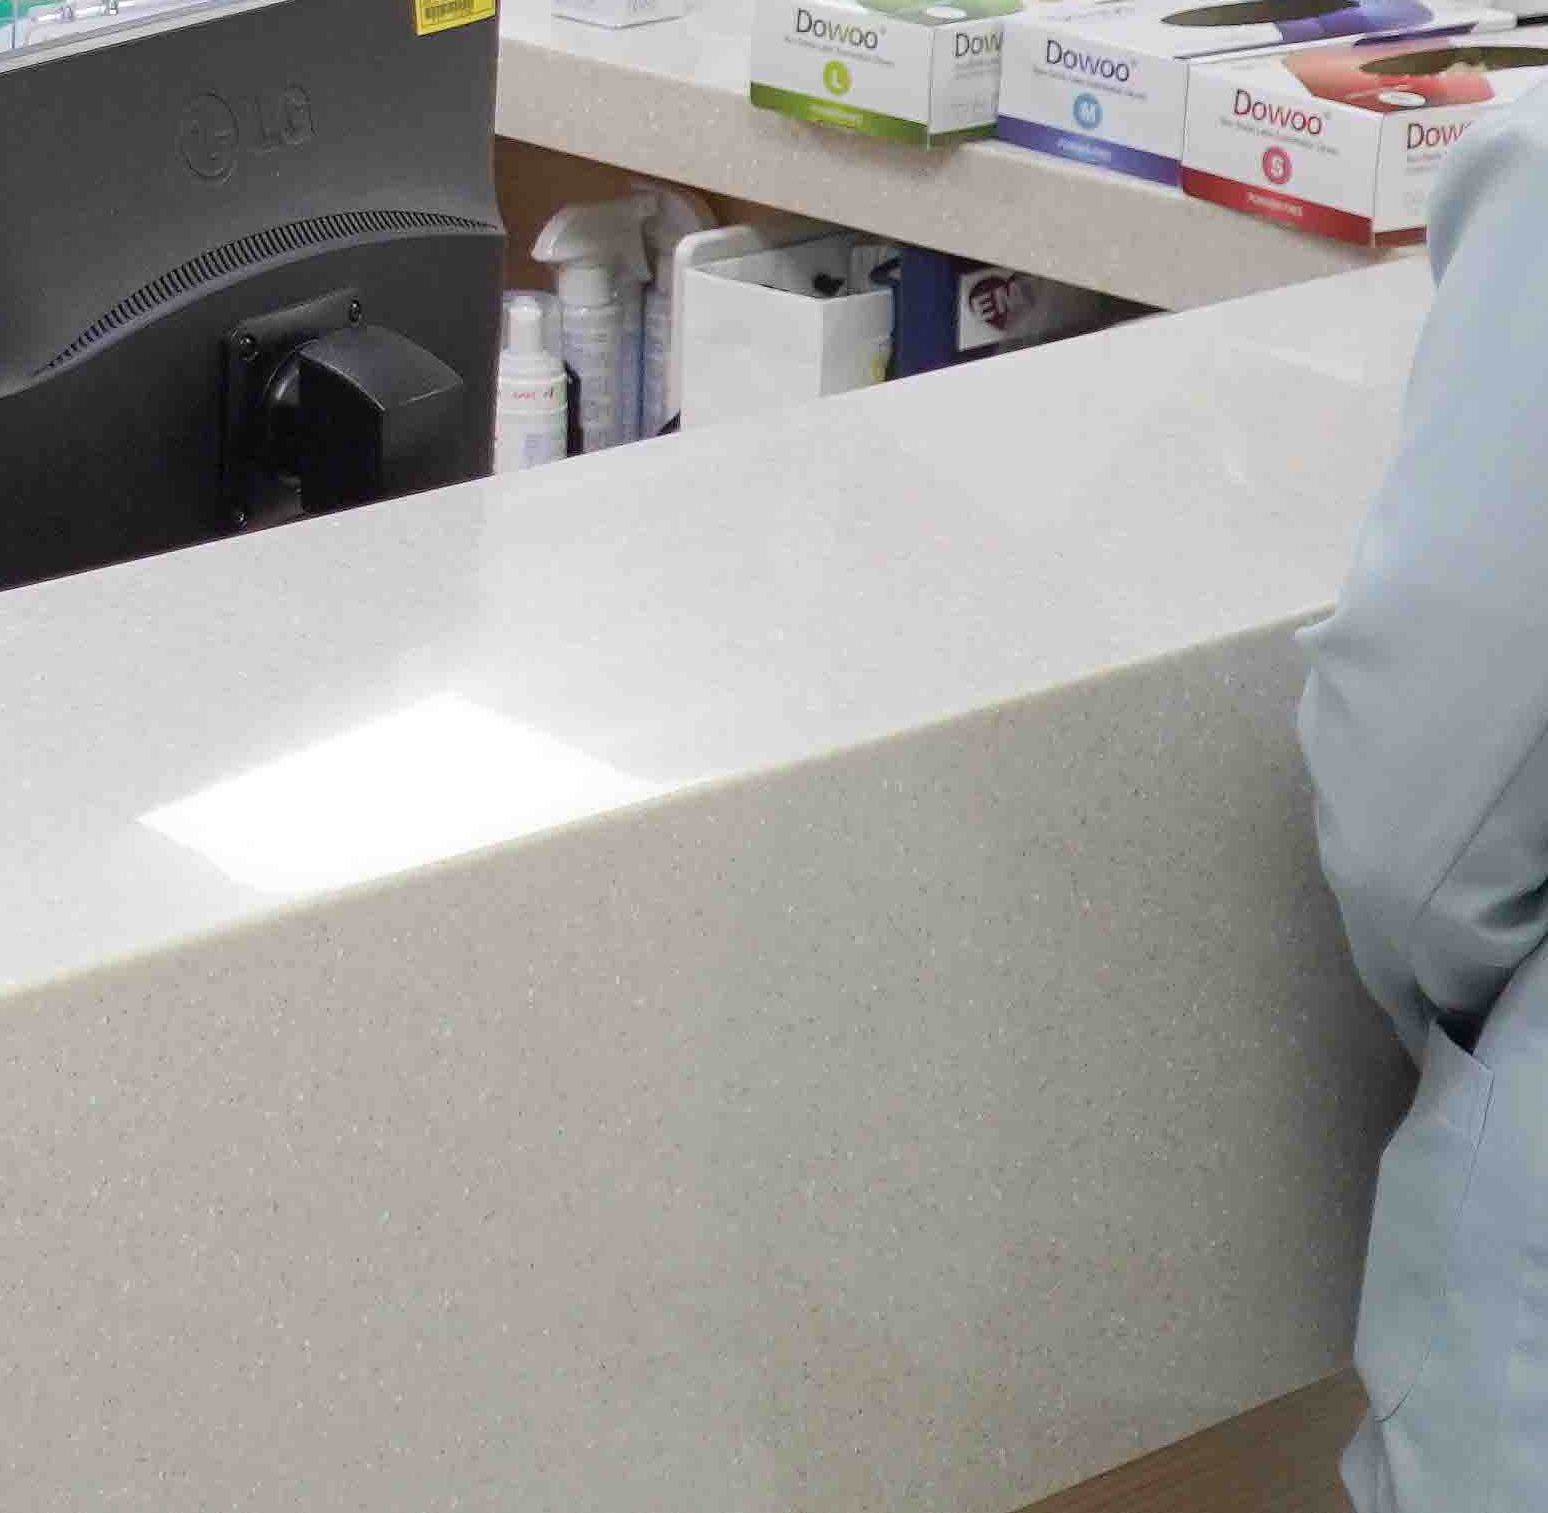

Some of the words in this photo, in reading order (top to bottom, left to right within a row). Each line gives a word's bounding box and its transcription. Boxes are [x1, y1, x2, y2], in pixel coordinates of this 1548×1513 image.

[955, 31, 1004, 58] Dow
[255, 82, 318, 153] LG
[1406, 120, 1472, 151] Dow
